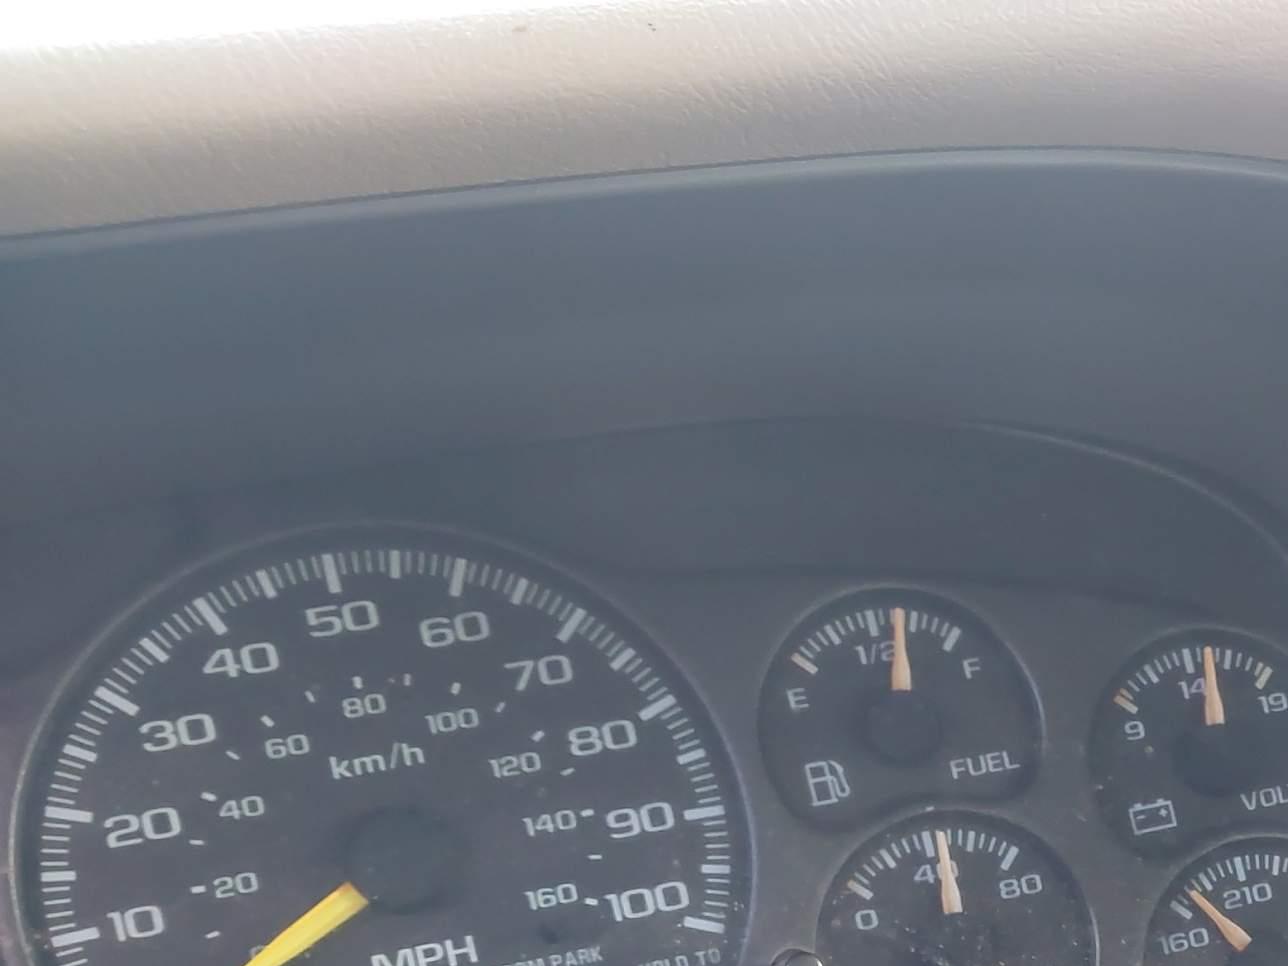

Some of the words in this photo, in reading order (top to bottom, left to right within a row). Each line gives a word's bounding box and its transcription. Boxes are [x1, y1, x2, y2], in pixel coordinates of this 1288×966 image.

[305, 599, 379, 638] 50
[418, 611, 491, 648] 60
[202, 642, 279, 679] 40
[503, 655, 573, 692] 70
[962, 658, 981, 679] F
[342, 693, 387, 718] 80
[787, 688, 809, 710] E
[1258, 693, 1288, 713] 19
[140, 713, 216, 752] 30
[424, 708, 479, 736] 100
[1124, 721, 1145, 740] 9
[265, 734, 311, 759] 60
[567, 719, 638, 757] 80
[329, 743, 426, 782] km/h
[489, 751, 542, 778] 120
[949, 750, 1020, 779] FUEL
[218, 795, 265, 822] 40
[605, 801, 675, 839] 90
[104, 807, 181, 849] 20
[522, 810, 578, 836] 140
[212, 872, 259, 898] 20
[525, 883, 579, 910] 160
[999, 874, 1042, 899] 80
[1223, 882, 1273, 910] 210
[603, 882, 690, 922] 100
[108, 905, 165, 941] 10
[855, 909, 878, 930] 0
[1158, 928, 1209, 955] 160
